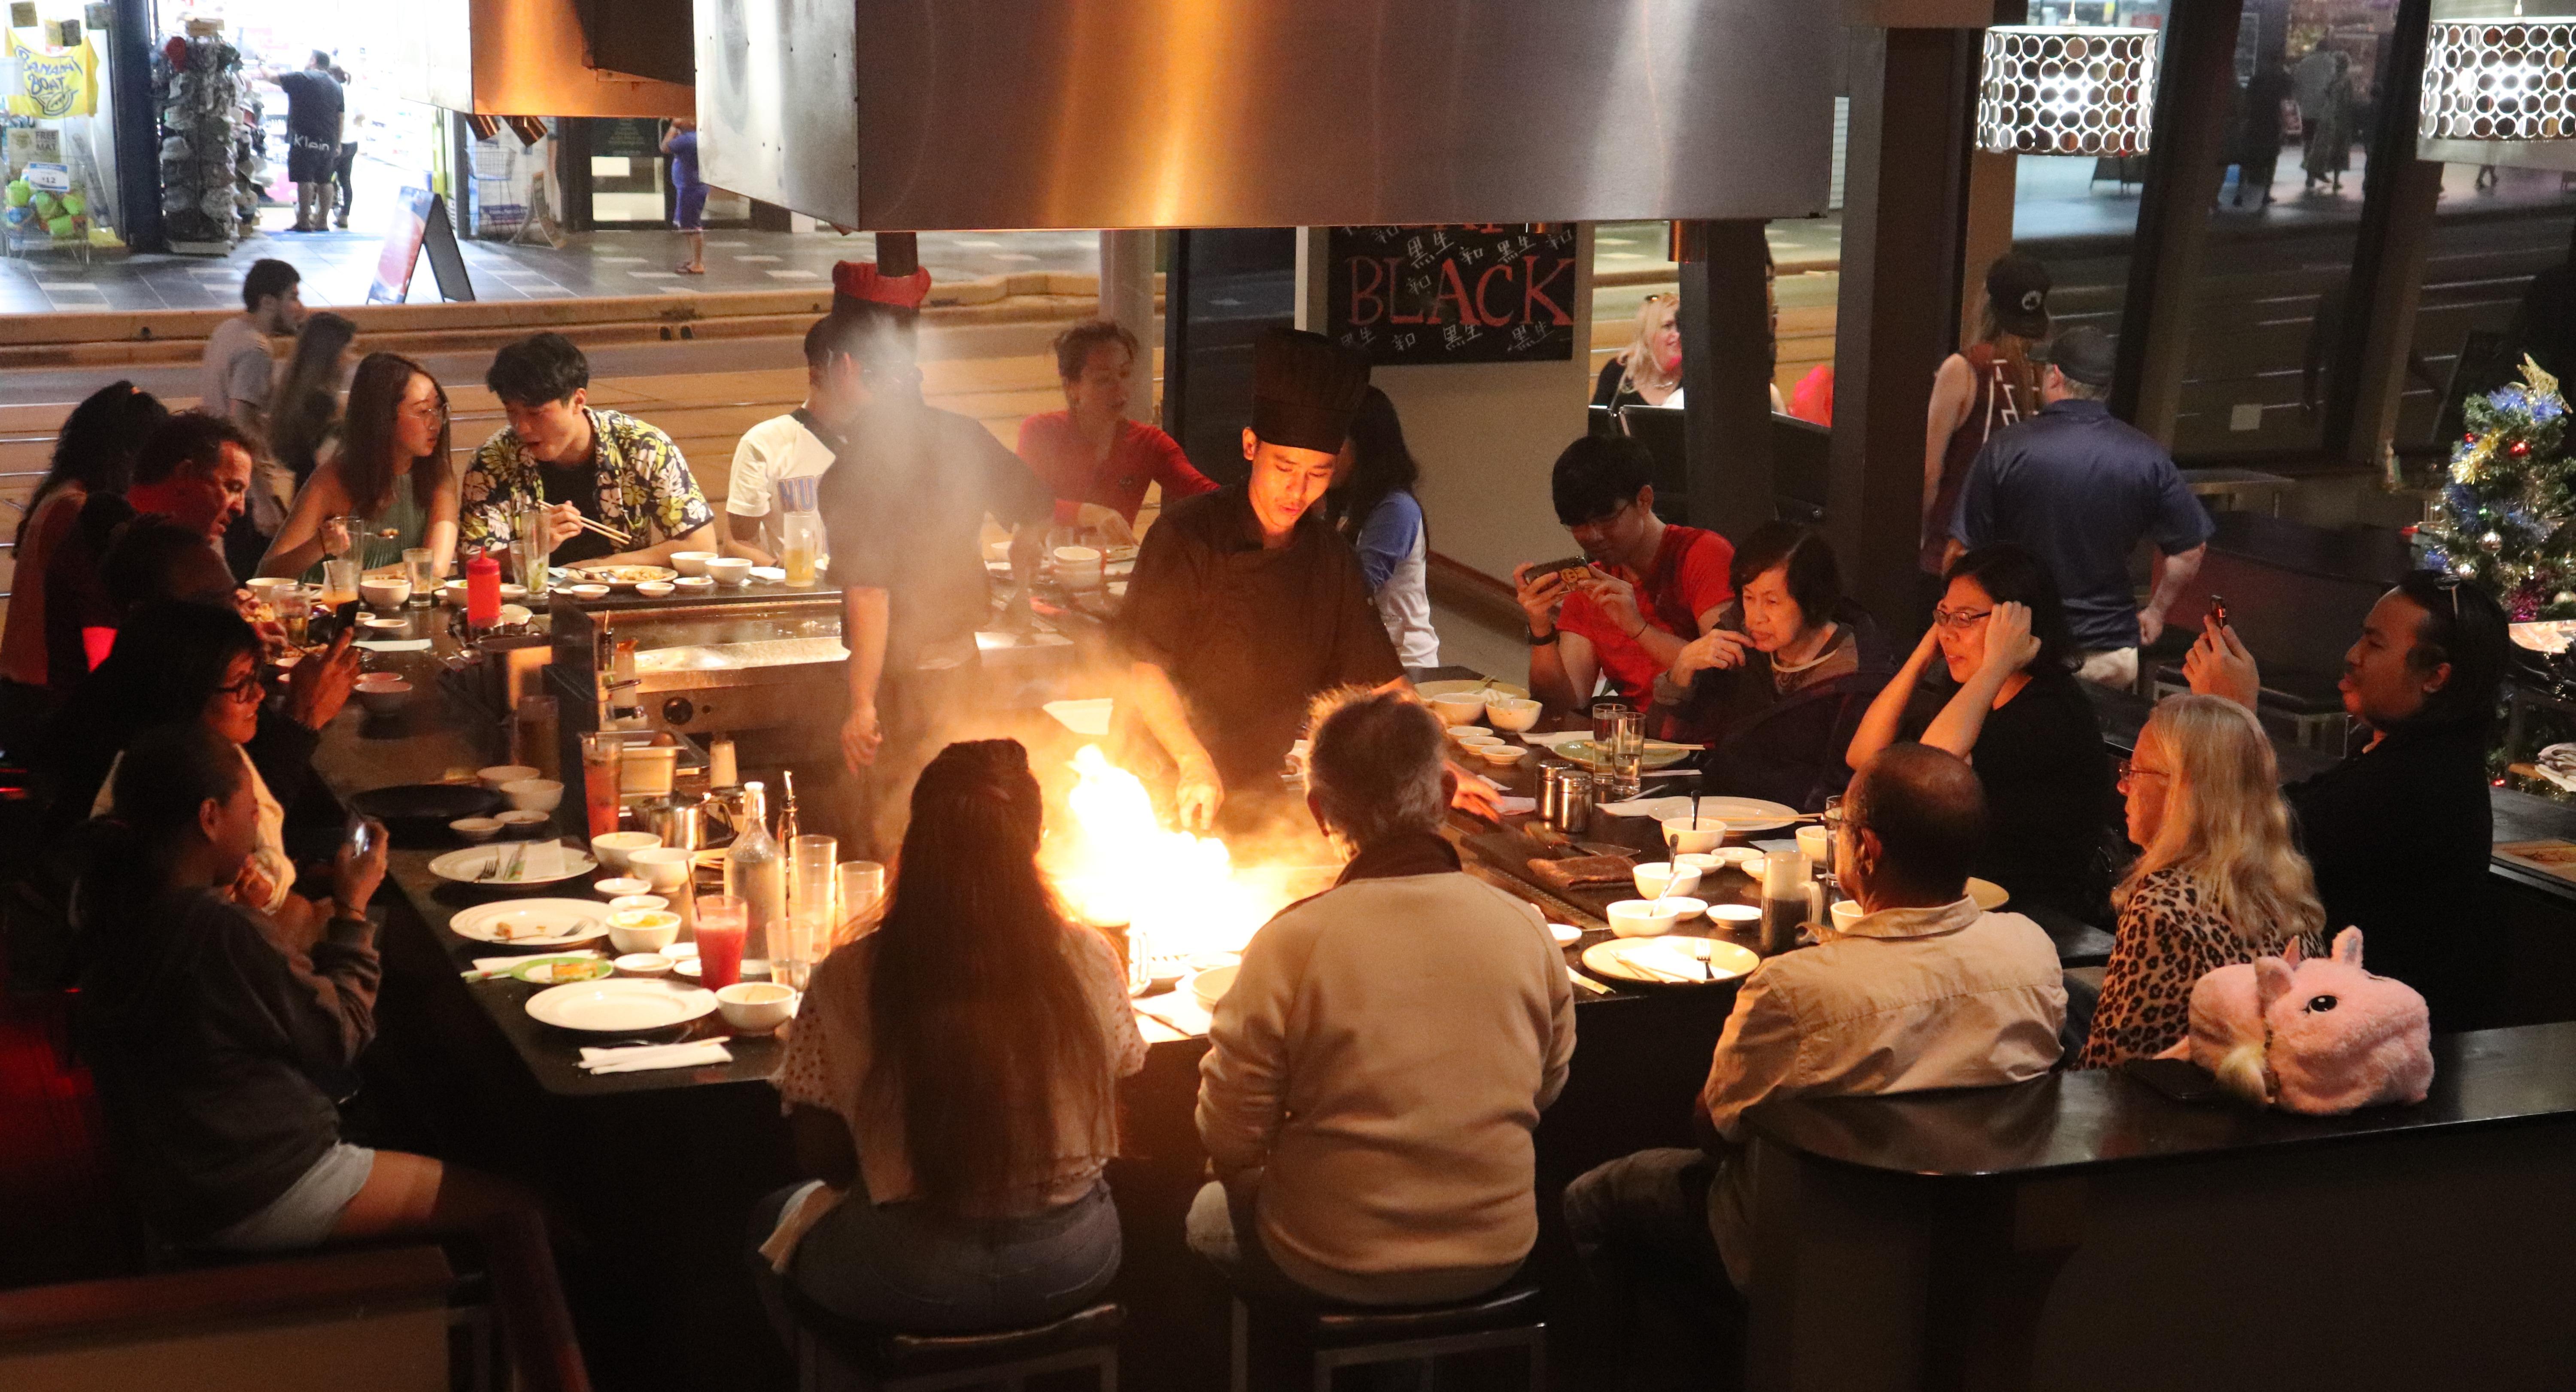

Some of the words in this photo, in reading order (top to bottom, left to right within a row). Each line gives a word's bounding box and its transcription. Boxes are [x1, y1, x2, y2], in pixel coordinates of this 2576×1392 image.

[28, 73, 65, 97] BOAT
[36, 131, 56, 140] FREE
[294, 133, 329, 151] Klein
[1346, 255, 1575, 327] BLACK
[777, 474, 823, 513] NU
